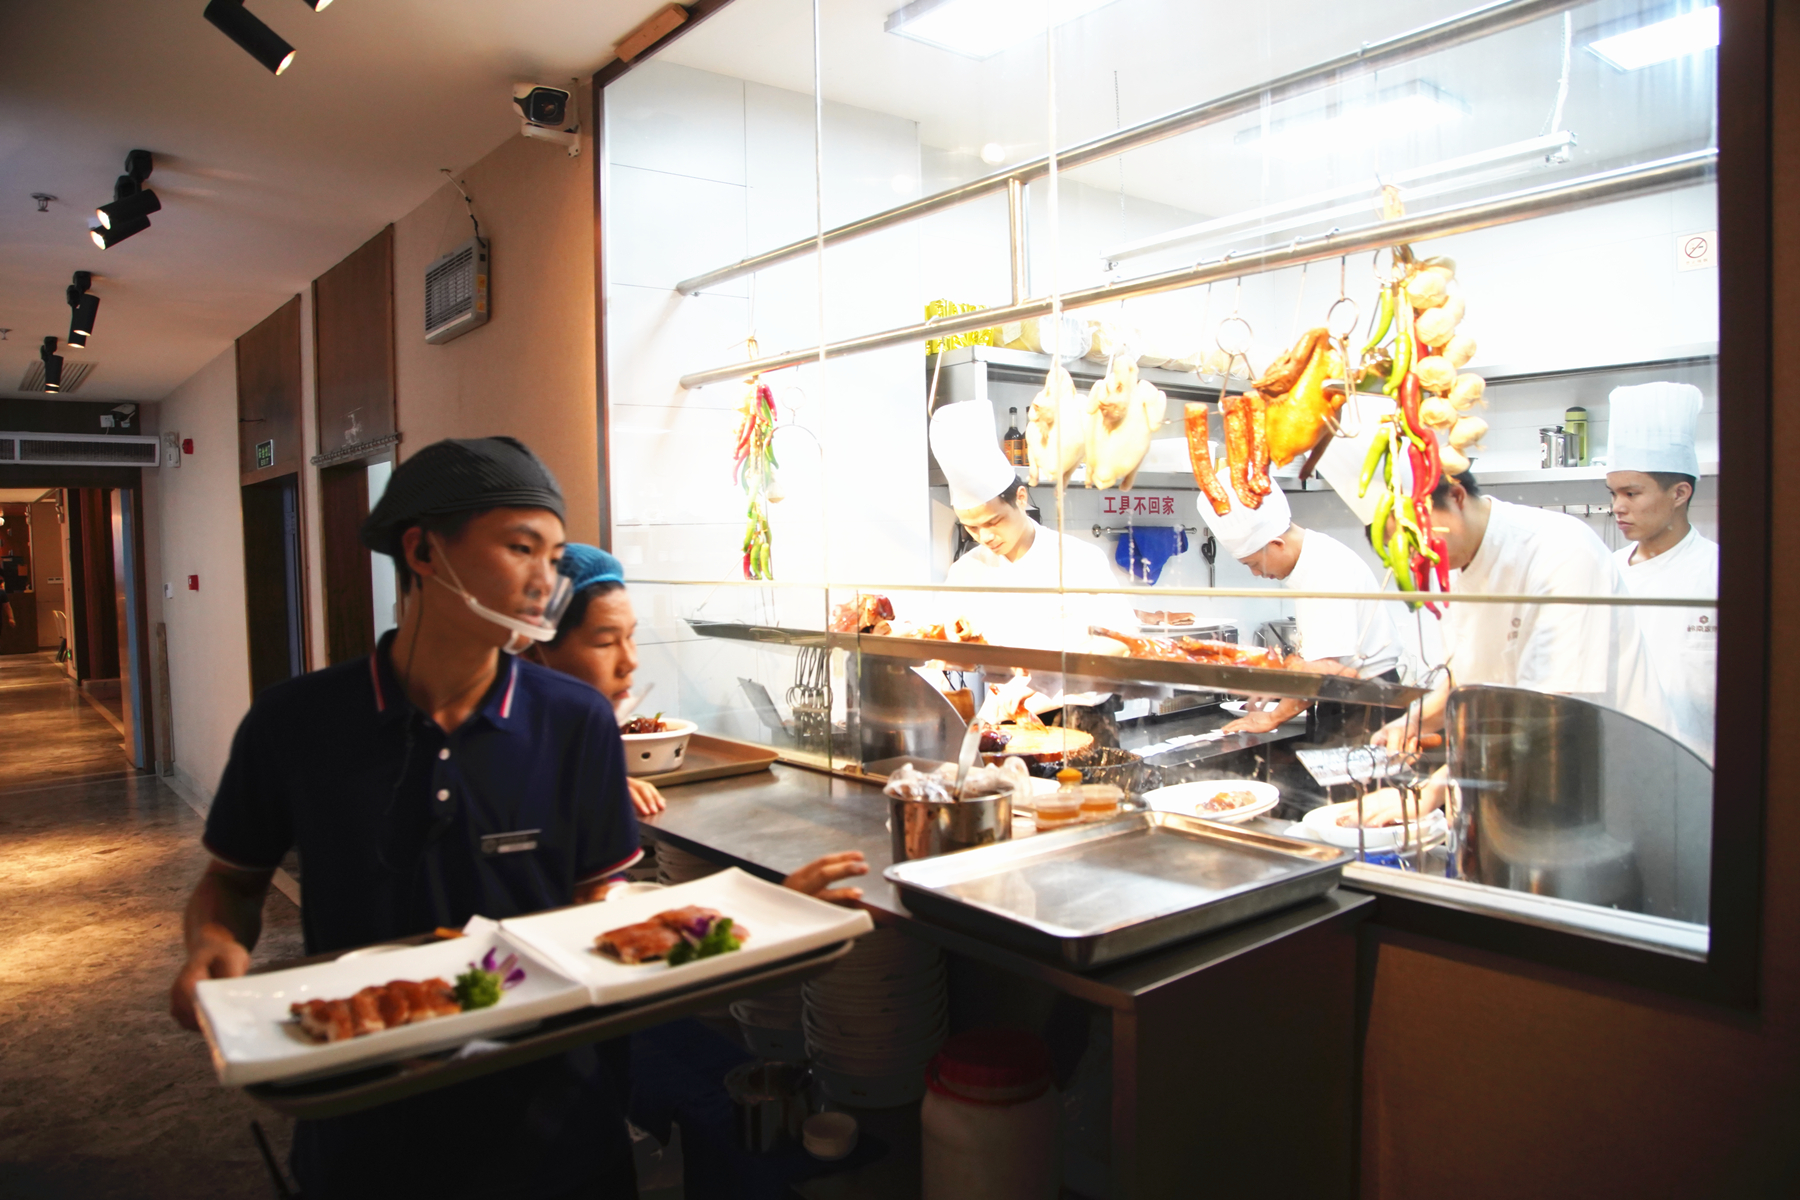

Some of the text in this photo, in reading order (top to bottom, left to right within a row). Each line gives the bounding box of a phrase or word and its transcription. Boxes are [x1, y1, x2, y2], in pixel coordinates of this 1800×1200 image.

[1103, 495, 1175, 516] 工具不回家
